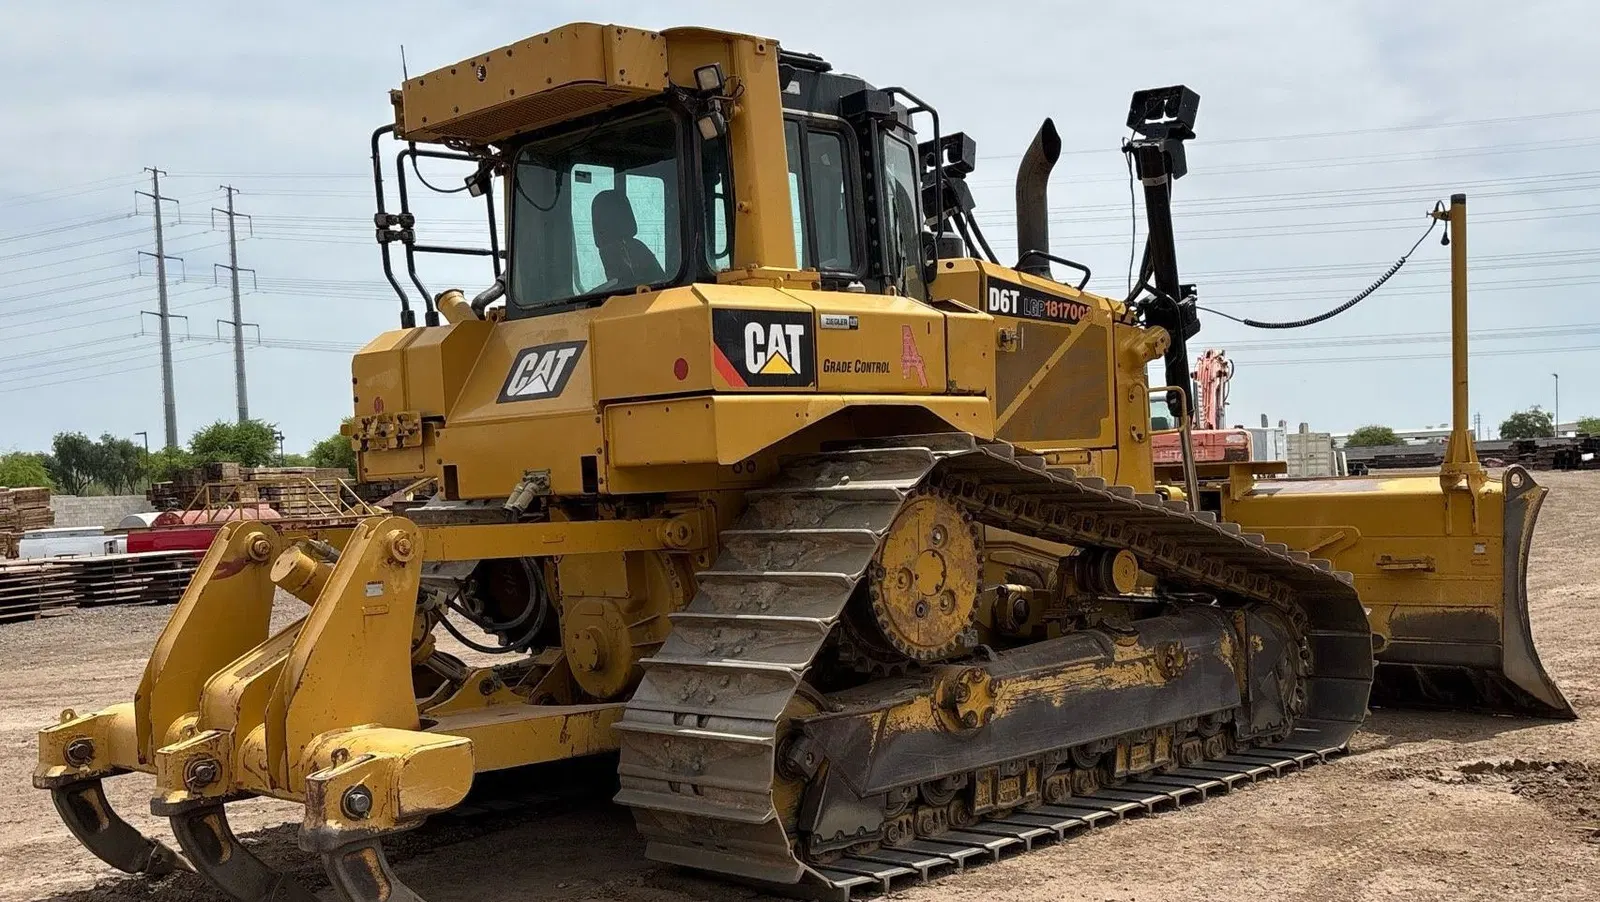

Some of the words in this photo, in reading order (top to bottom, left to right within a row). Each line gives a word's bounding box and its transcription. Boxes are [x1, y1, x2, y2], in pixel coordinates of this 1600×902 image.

[989, 287, 1020, 314] D6T
[1023, 298, 1045, 317] LGP
[825, 317, 848, 327] ZIEGLER
[744, 322, 804, 375] CAT
[506, 347, 577, 397] CAT
[823, 359, 852, 373] GRADE
[854, 359, 891, 374] CONTROL
[1160, 449, 1208, 460] HITHI
